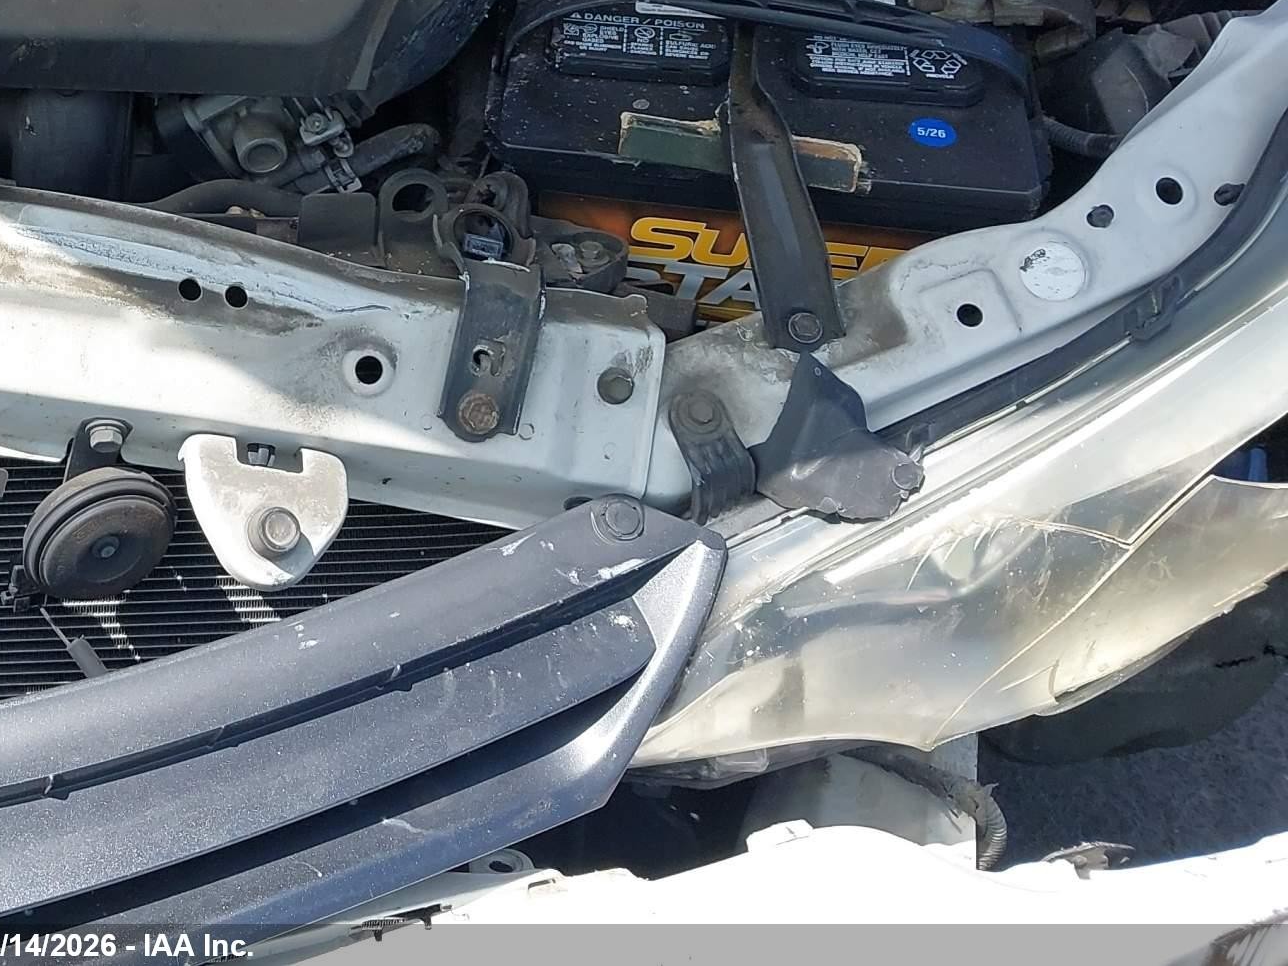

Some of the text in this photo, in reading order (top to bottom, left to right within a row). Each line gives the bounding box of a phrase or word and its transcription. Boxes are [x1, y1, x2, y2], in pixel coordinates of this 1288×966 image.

[584, 13, 640, 24] DANGER
[654, 19, 705, 30] POISON
[917, 127, 946, 138] 5/26
